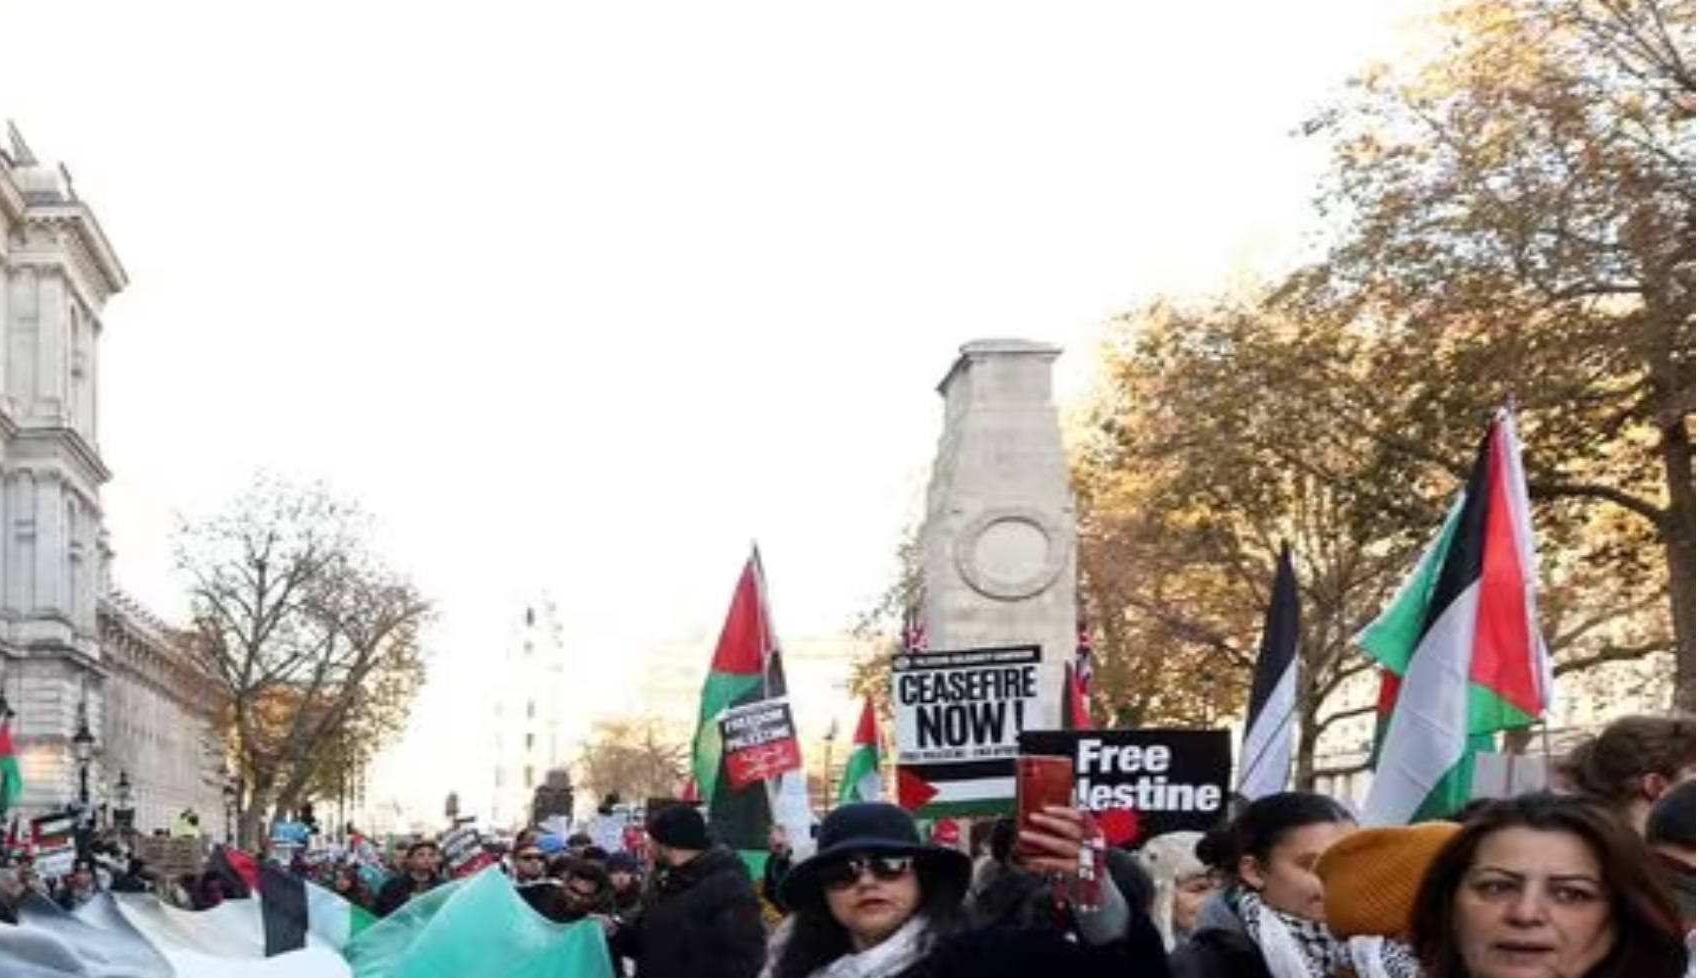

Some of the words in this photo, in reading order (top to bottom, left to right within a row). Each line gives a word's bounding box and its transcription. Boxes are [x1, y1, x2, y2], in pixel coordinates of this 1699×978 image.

[900, 666, 1037, 705] CEASEFIRE
[1078, 739, 1170, 774] Free
[1077, 776, 1221, 811] lestine
